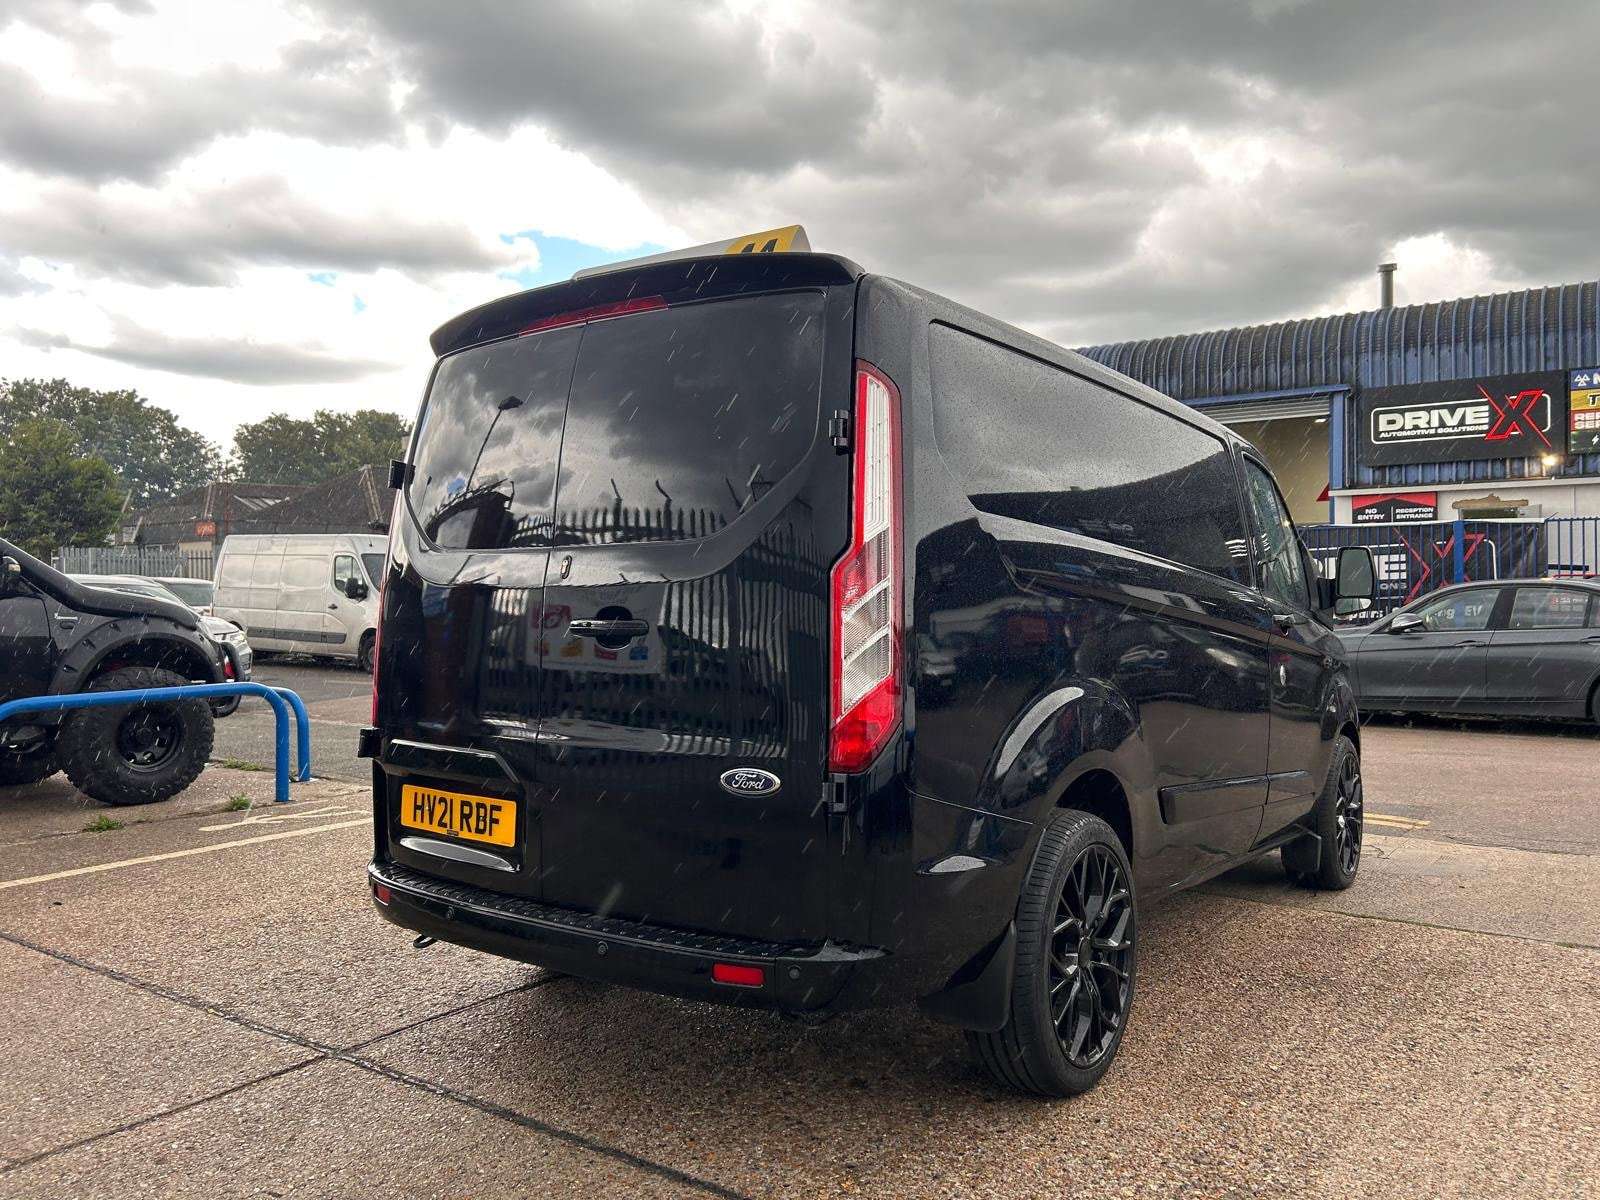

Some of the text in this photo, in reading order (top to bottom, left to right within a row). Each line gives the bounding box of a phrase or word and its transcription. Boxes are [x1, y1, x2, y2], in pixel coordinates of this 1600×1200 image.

[1378, 405, 1489, 431] DRIVE
[1379, 424, 1489, 438] AUTOMOTIVE SOLUTIONS
[1357, 513, 1385, 521] ENTRY
[731, 773, 766, 790] Ford
[413, 791, 503, 837] HV21 RBF
